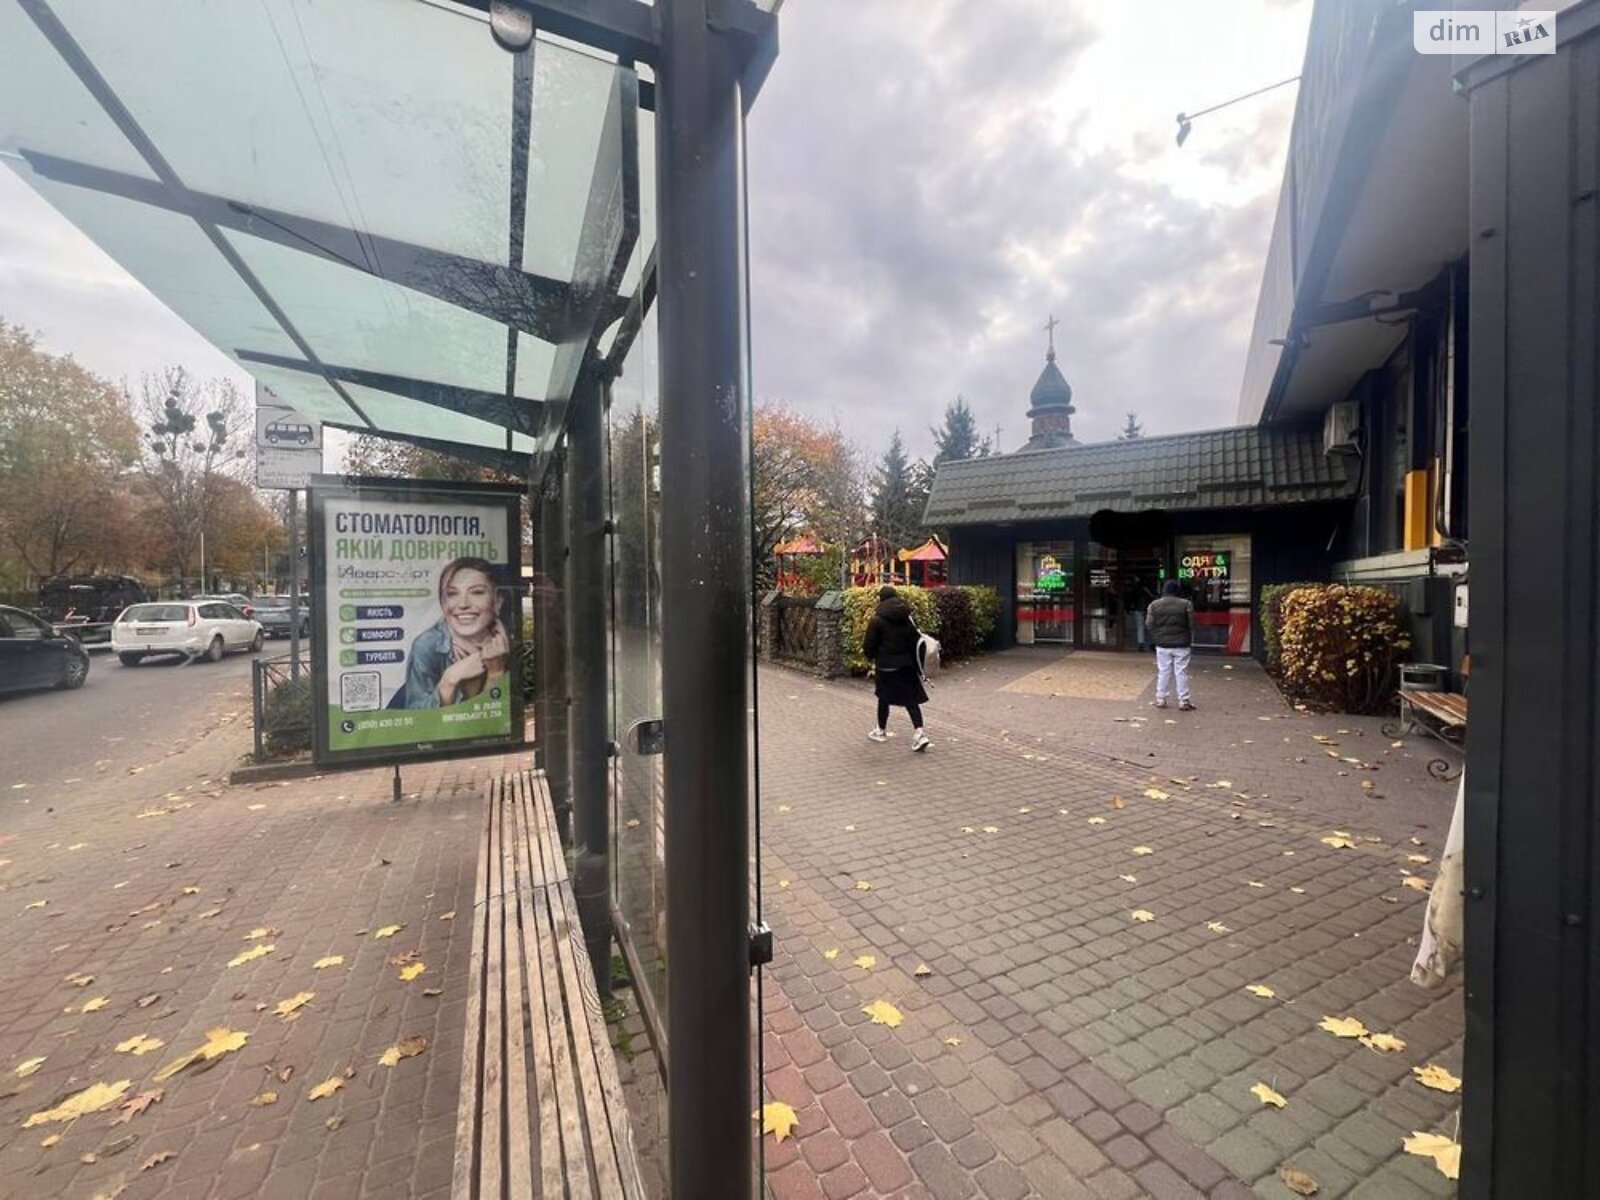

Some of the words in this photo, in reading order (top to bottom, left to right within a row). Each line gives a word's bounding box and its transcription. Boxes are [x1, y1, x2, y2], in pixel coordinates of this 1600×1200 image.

[335, 511, 486, 539] СТОМАТОЛОГІЯ,
[335, 535, 384, 560] ЯКІЙ
[388, 537, 500, 562] ДОВІРЯЮТЬ
[1178, 566, 1227, 579] ВЗУТТЯ
[361, 629, 398, 640] КОМФОРТ
